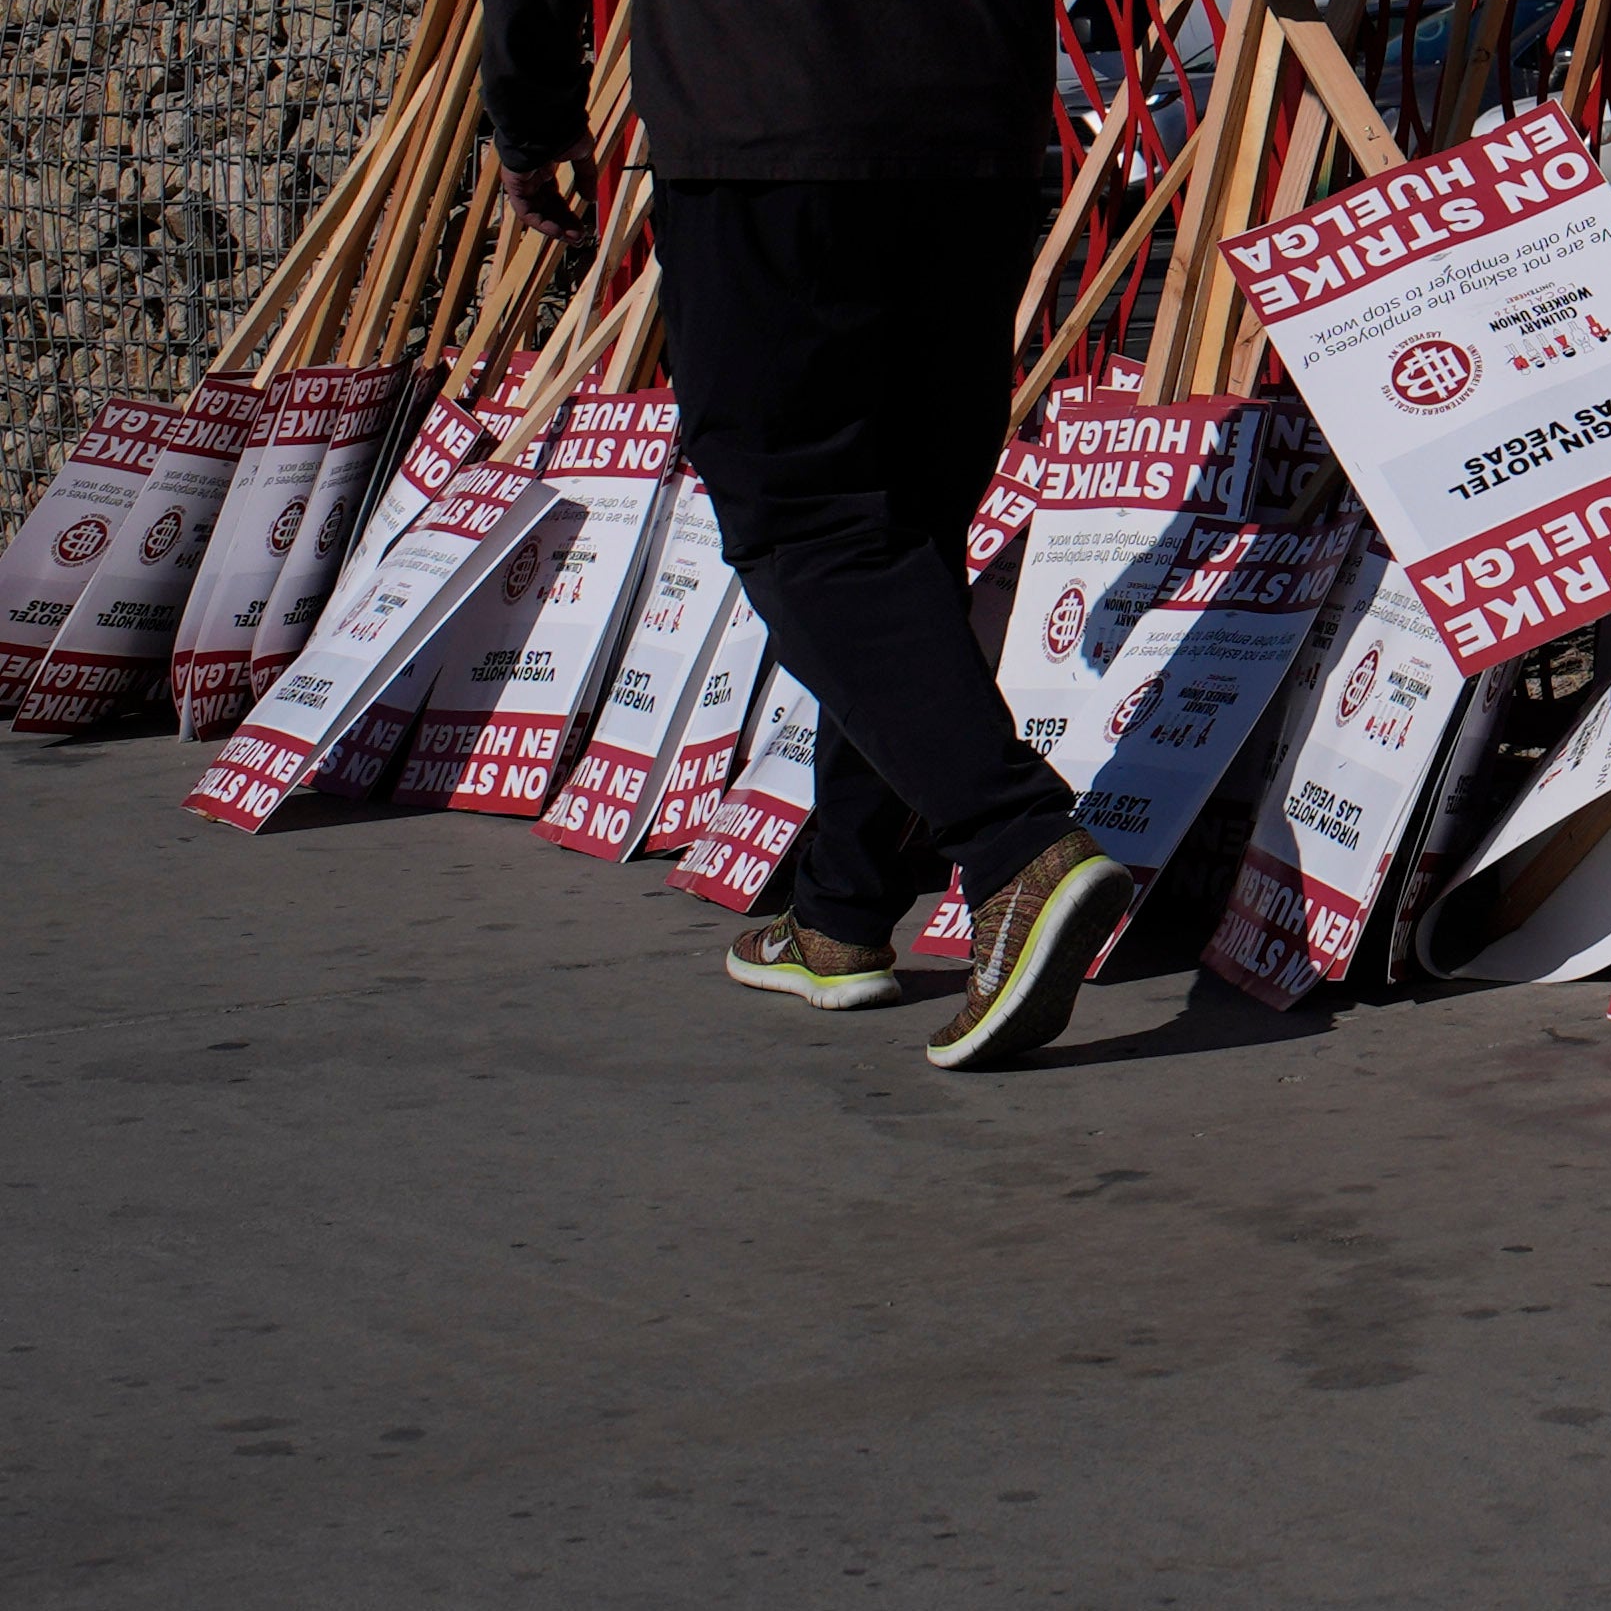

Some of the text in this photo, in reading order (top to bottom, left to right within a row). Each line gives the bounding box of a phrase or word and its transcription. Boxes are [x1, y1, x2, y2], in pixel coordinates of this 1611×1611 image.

[1228, 112, 1568, 273] EN HUELGA
[1249, 151, 1589, 315] ON STRIKE
[1555, 238, 1584, 258] are
[1309, 215, 1596, 344] any other employer to stop work.
[1458, 266, 1517, 295] asking
[1521, 252, 1551, 273] not
[1426, 289, 1455, 309] the
[1488, 286, 1593, 332] WORKERS UNION
[1324, 304, 1422, 356] employees
[1518, 305, 1577, 336] CULINARY
[1303, 351, 1320, 369] of
[1058, 417, 1191, 455] HUELGA
[1463, 420, 1570, 475] VEGAS
[1042, 461, 1174, 500] STRIKE
[1447, 445, 1553, 500] HOTEL
[471, 666, 555, 682] VIRGIN HOTEL
[483, 647, 552, 666] LAS VEGAS
[418, 724, 560, 760] EN HUELGA
[402, 761, 549, 800] ON STRIKE
[606, 764, 648, 804] EN
[1300, 780, 1363, 826] LAS VEGAS
[588, 802, 631, 845] ON
[1285, 796, 1360, 851] VIRGIN HOTEL
[1307, 905, 1350, 956] EN
